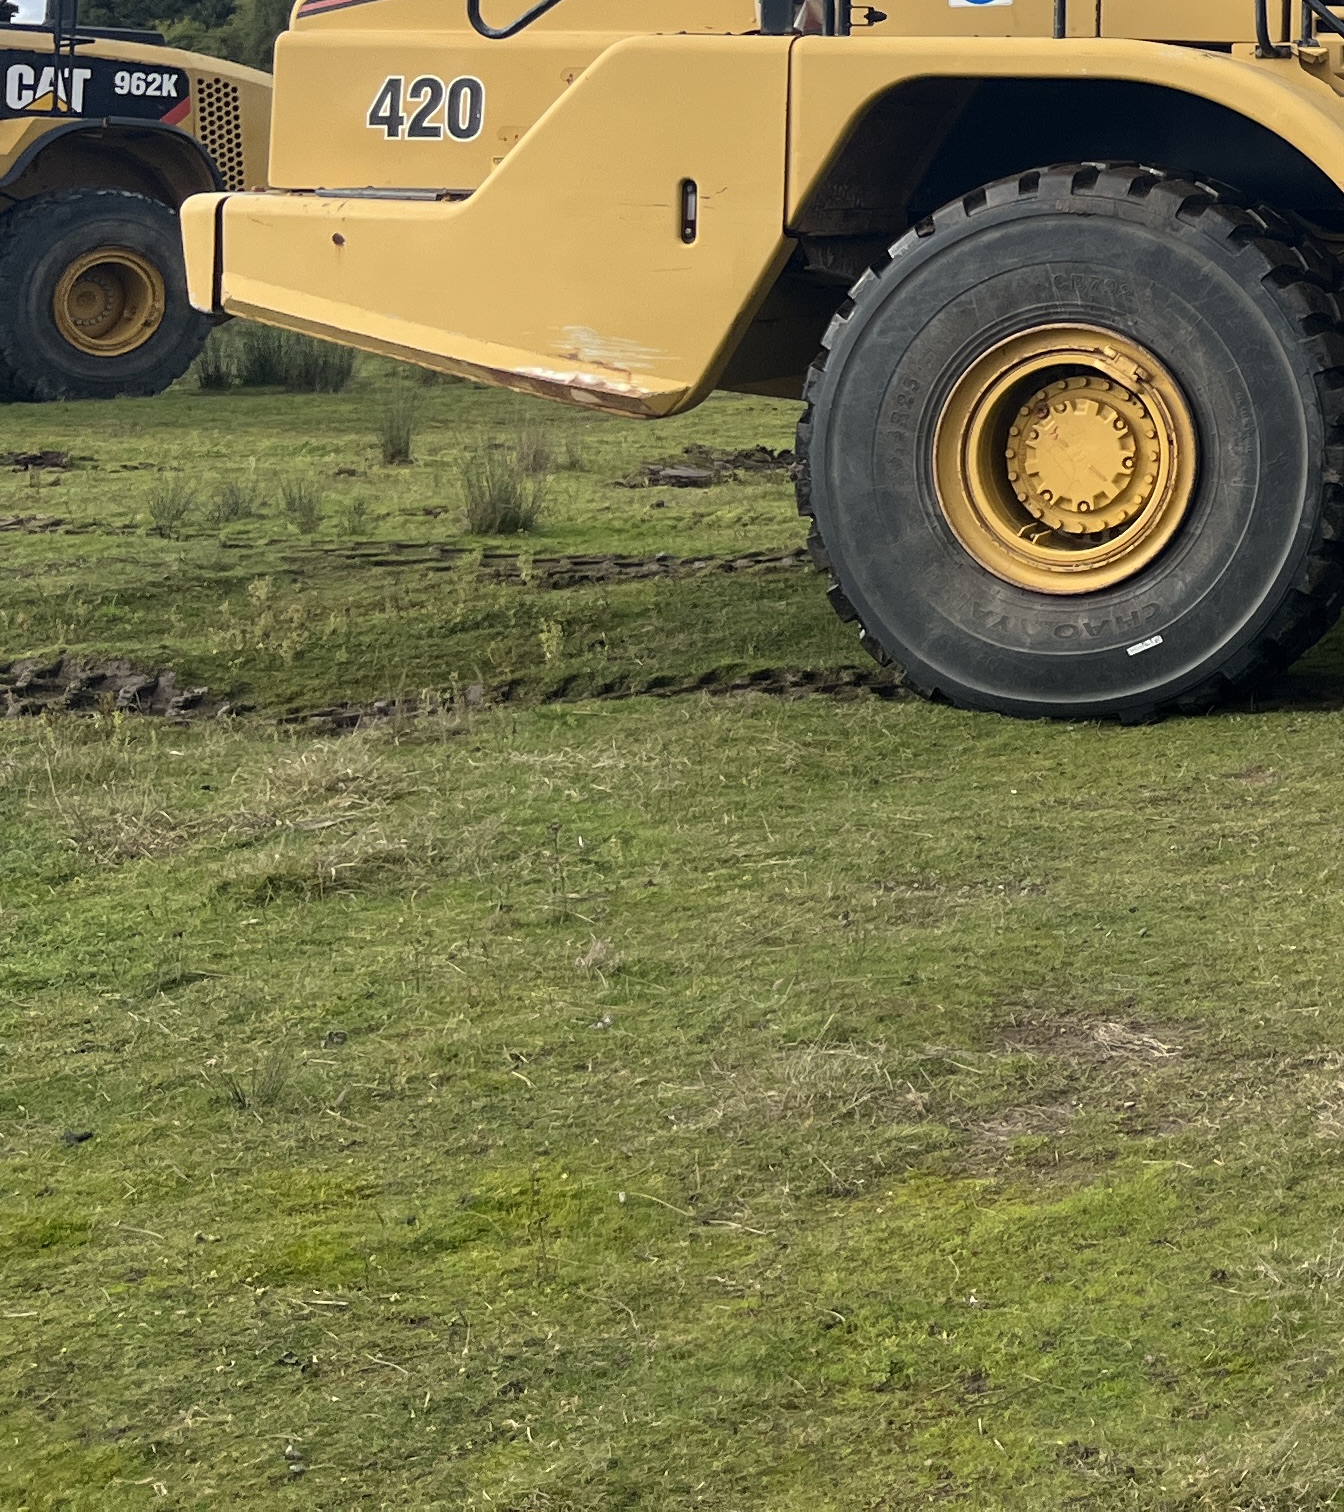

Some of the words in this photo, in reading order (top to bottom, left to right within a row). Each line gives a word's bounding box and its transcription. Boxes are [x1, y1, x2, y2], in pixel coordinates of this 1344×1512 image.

[5, 63, 92, 114] CAT
[114, 70, 179, 98] 962K
[365, 74, 486, 143] 420
